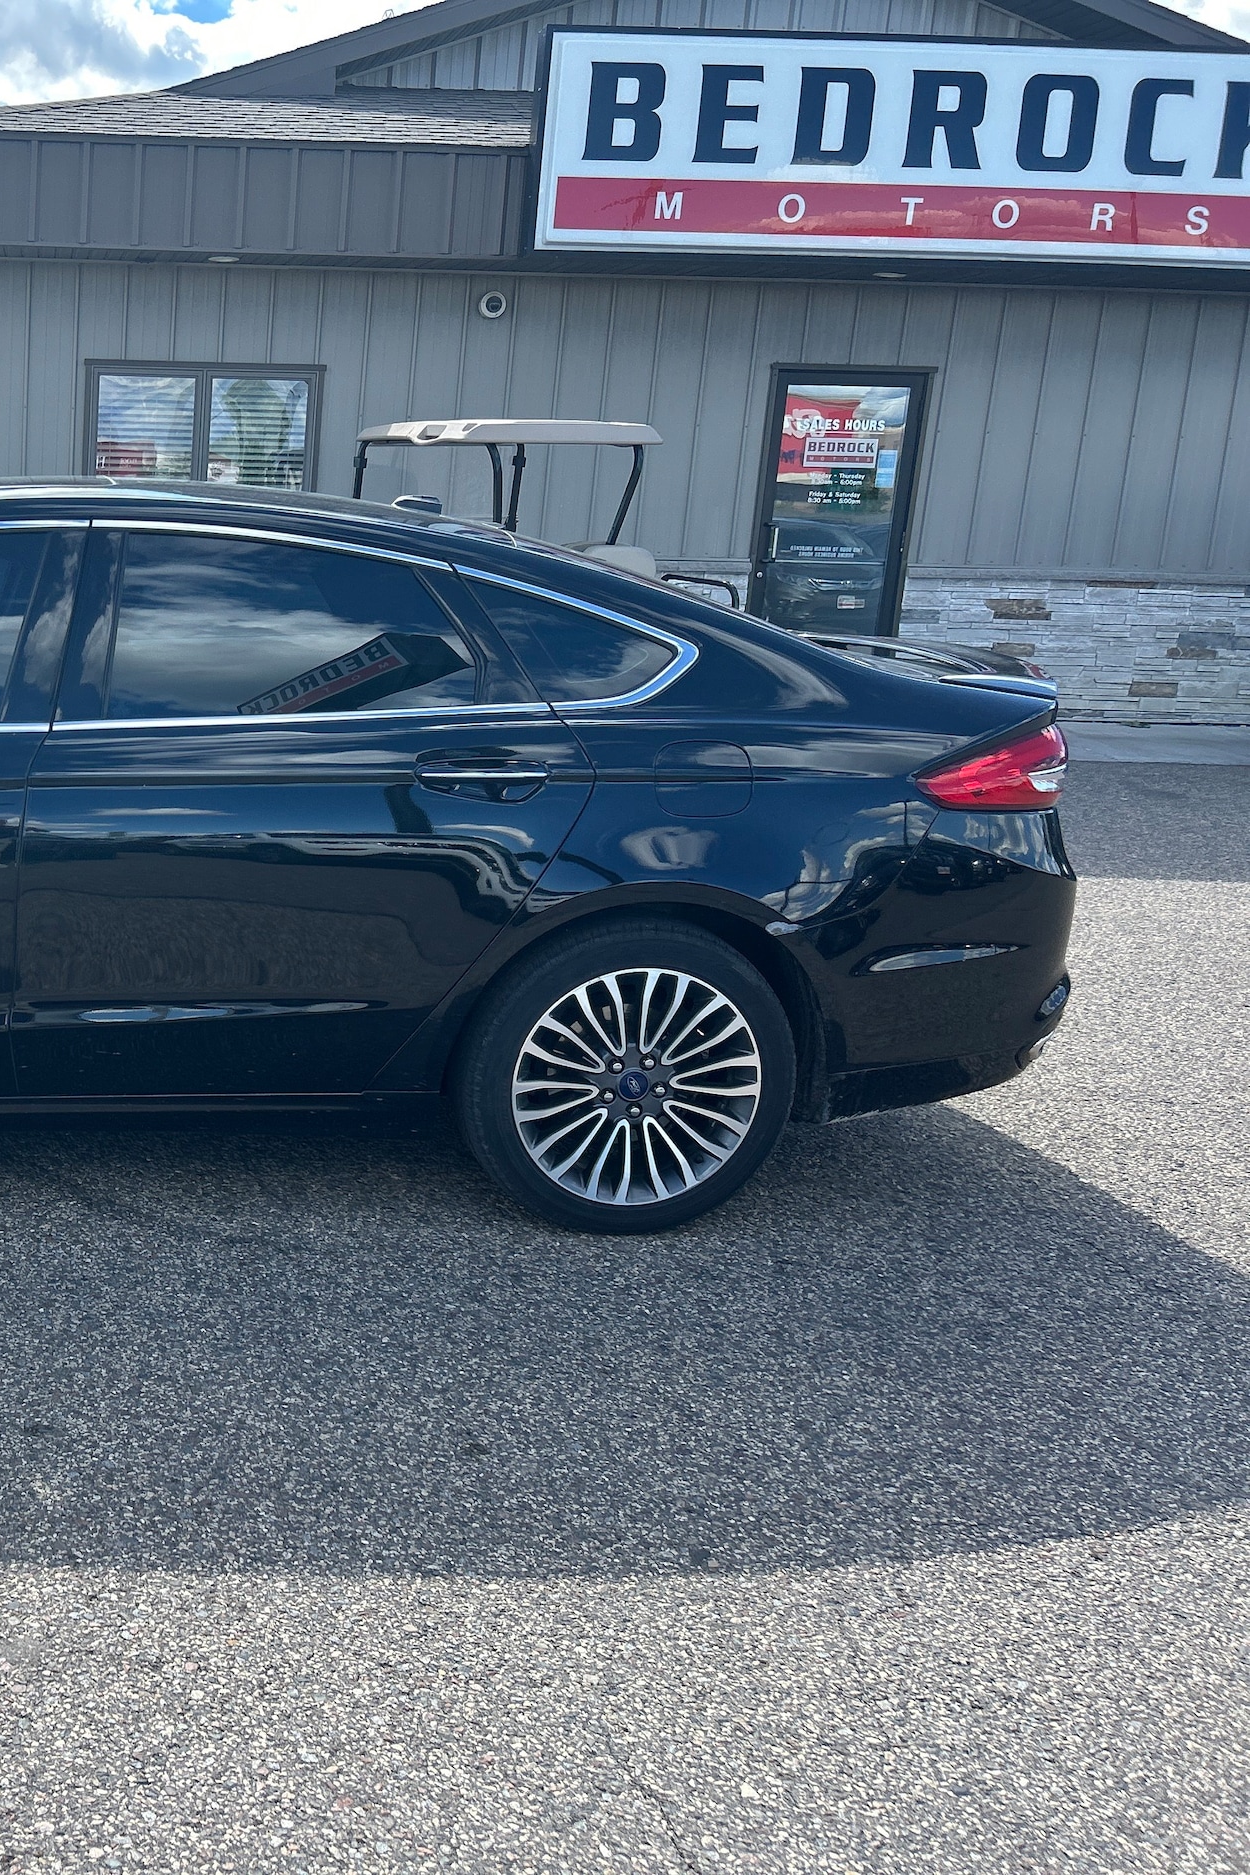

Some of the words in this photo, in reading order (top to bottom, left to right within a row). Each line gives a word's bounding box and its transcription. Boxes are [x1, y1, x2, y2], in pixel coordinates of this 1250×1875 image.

[653, 190, 1211, 236] MOTORS
[801, 419, 840, 431] SALES
[844, 419, 886, 431] HOURS
[807, 441, 875, 453] BEDROCK
[808, 490, 827, 498] Friday
[834, 491, 862, 499] Saturday
